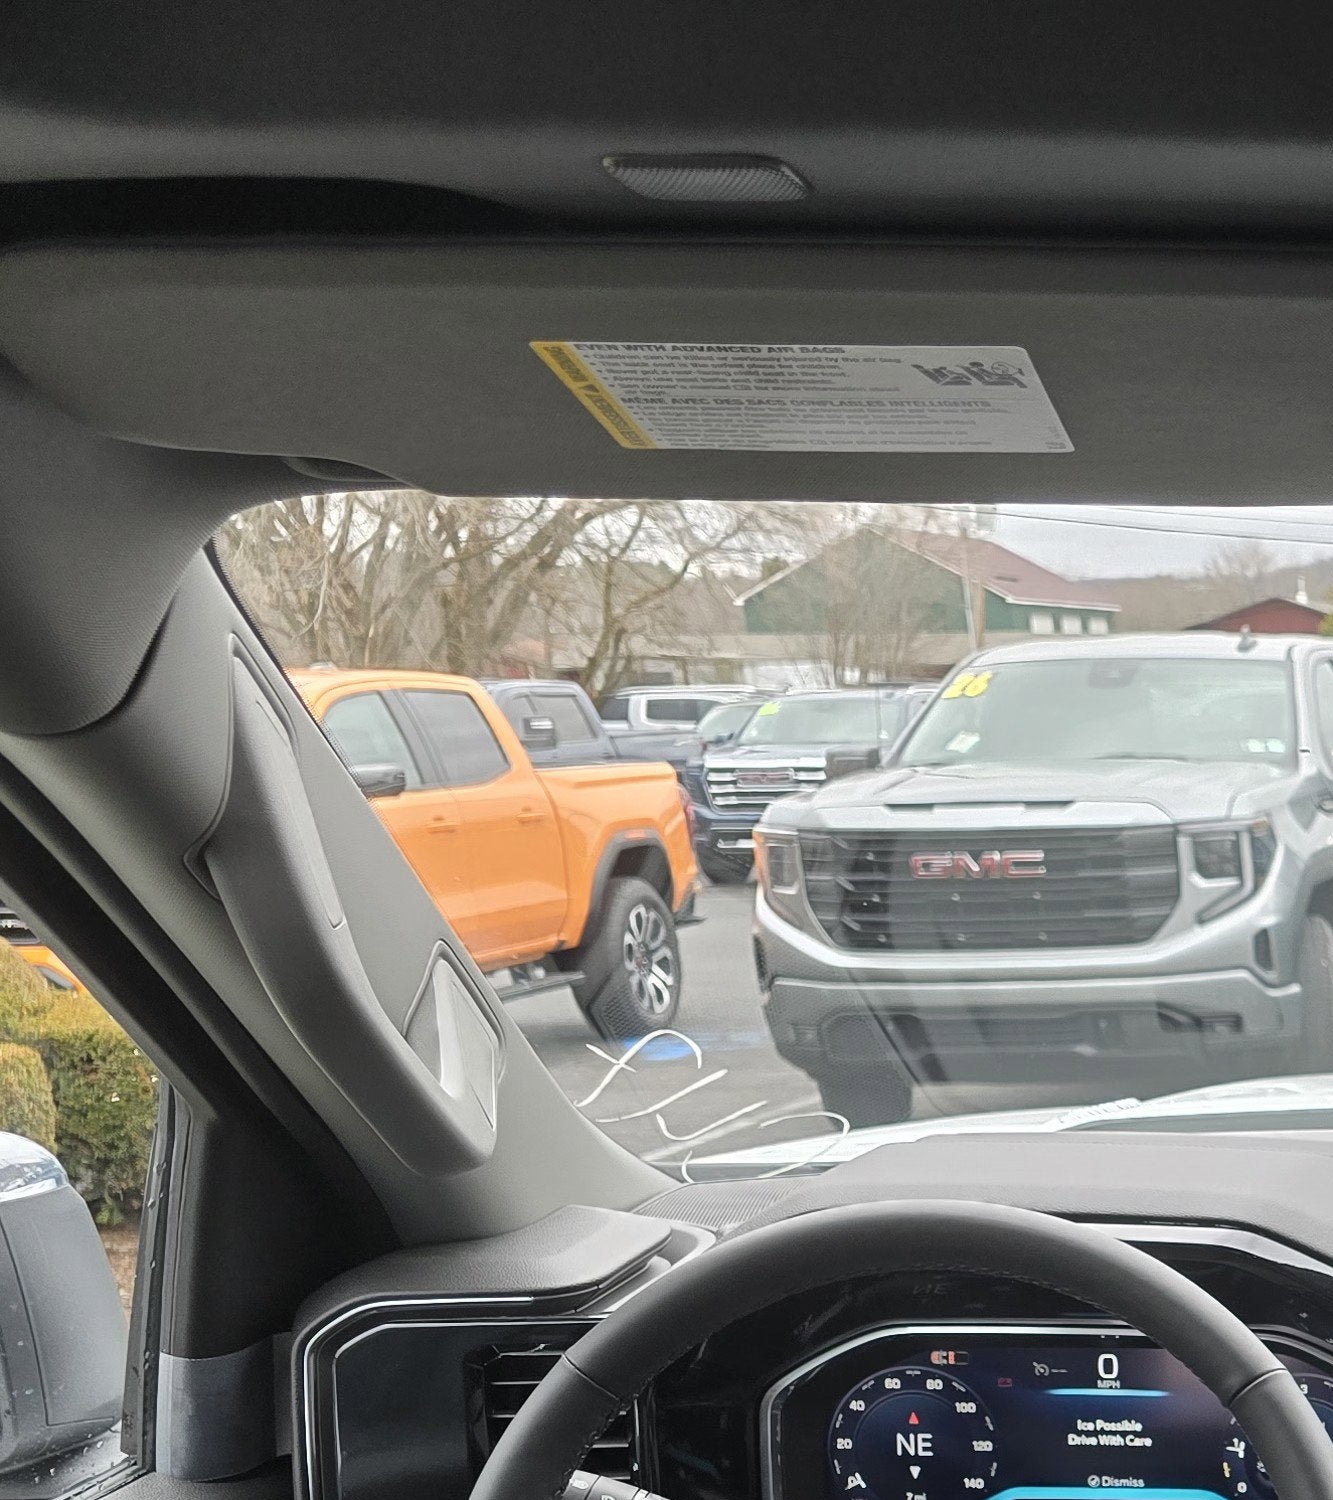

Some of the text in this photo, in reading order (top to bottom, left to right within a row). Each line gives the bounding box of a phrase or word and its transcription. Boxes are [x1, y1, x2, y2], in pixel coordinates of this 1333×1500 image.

[909, 850, 1047, 879] GMC
[1097, 1353, 1119, 1379] 0
[884, 1378, 901, 1389] 60
[1097, 1380, 1120, 1389] MPH
[849, 1400, 866, 1412] 40
[955, 1402, 977, 1413] 100
[1077, 1419, 1143, 1432] Ice Possible
[836, 1438, 853, 1450] 20
[896, 1432, 934, 1457] NE
[972, 1440, 993, 1451] 120
[1067, 1433, 1153, 1447] Drive With Care
[963, 1478, 985, 1489] 140
[1101, 1476, 1145, 1488] Dismiss
